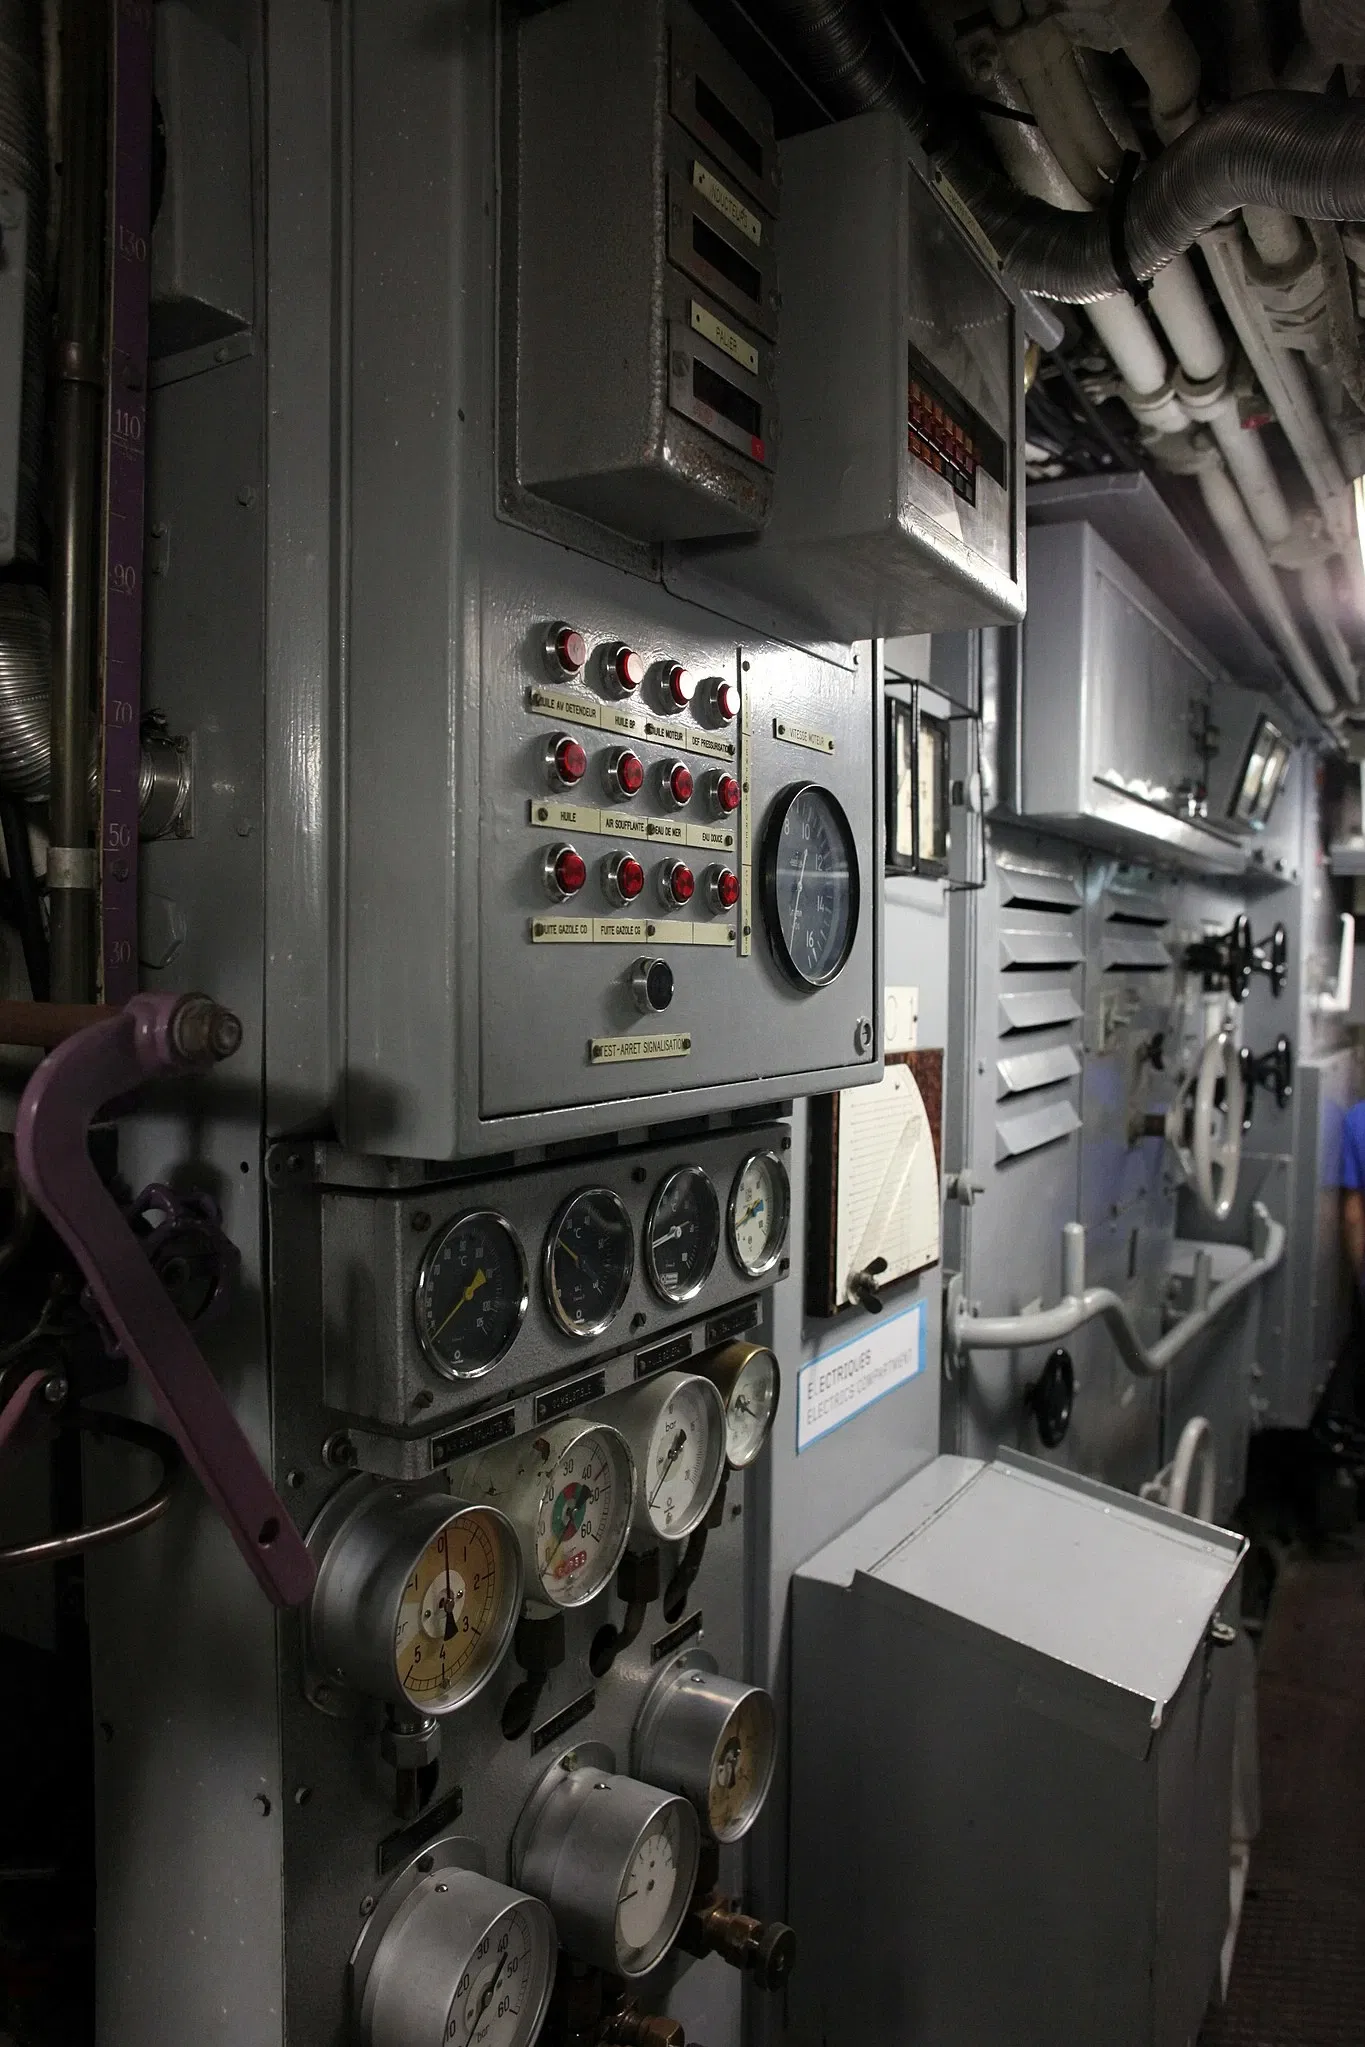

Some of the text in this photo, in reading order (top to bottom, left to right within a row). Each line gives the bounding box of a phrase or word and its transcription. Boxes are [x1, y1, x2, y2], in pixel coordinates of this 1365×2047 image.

[116, 408, 141, 441] 110
[114, 565, 136, 589] 90
[112, 700, 132, 724] 70
[556, 700, 564, 711] AV
[565, 703, 597, 718] DETENDEUR
[614, 715, 636, 729] HUILE BP
[665, 729, 683, 741] MOTEUR
[789, 727, 825, 746] VITESSE MOTEUR
[560, 811, 576, 822] HUILE
[605, 819, 645, 832] AIR SOUFFLANTE
[655, 826, 682, 837] EAU DE MER
[784, 818, 790, 836] 8
[802, 823, 810, 841] 10
[109, 823, 130, 847] 50
[702, 833, 723, 844] EAU DOUCE
[815, 853, 823, 871] 12
[817, 895, 825, 912] 14
[558, 924, 579, 935] GAZOLE
[600, 925, 615, 935] FUITE
[616, 925, 634, 936] GAZOLE
[806, 930, 814, 947] 16
[600, 1042, 641, 1057] TEST-ARRET
[563, 1457, 574, 1477] 30
[582, 1464, 592, 1481] 40
[581, 1520, 592, 1538] 60
[437, 1537, 444, 1553] 0
[463, 1550, 467, 1562] 1
[473, 1573, 480, 1590] 2
[463, 1616, 469, 1632] 3
[414, 1645, 421, 1663] 5
[439, 1644, 446, 1659] 4
[477, 1937, 490, 1960] 30
[497, 1933, 508, 1953] 40
[507, 1956, 518, 1979] 50
[498, 1995, 510, 2018] 60
[477, 2024, 490, 2043] bar
